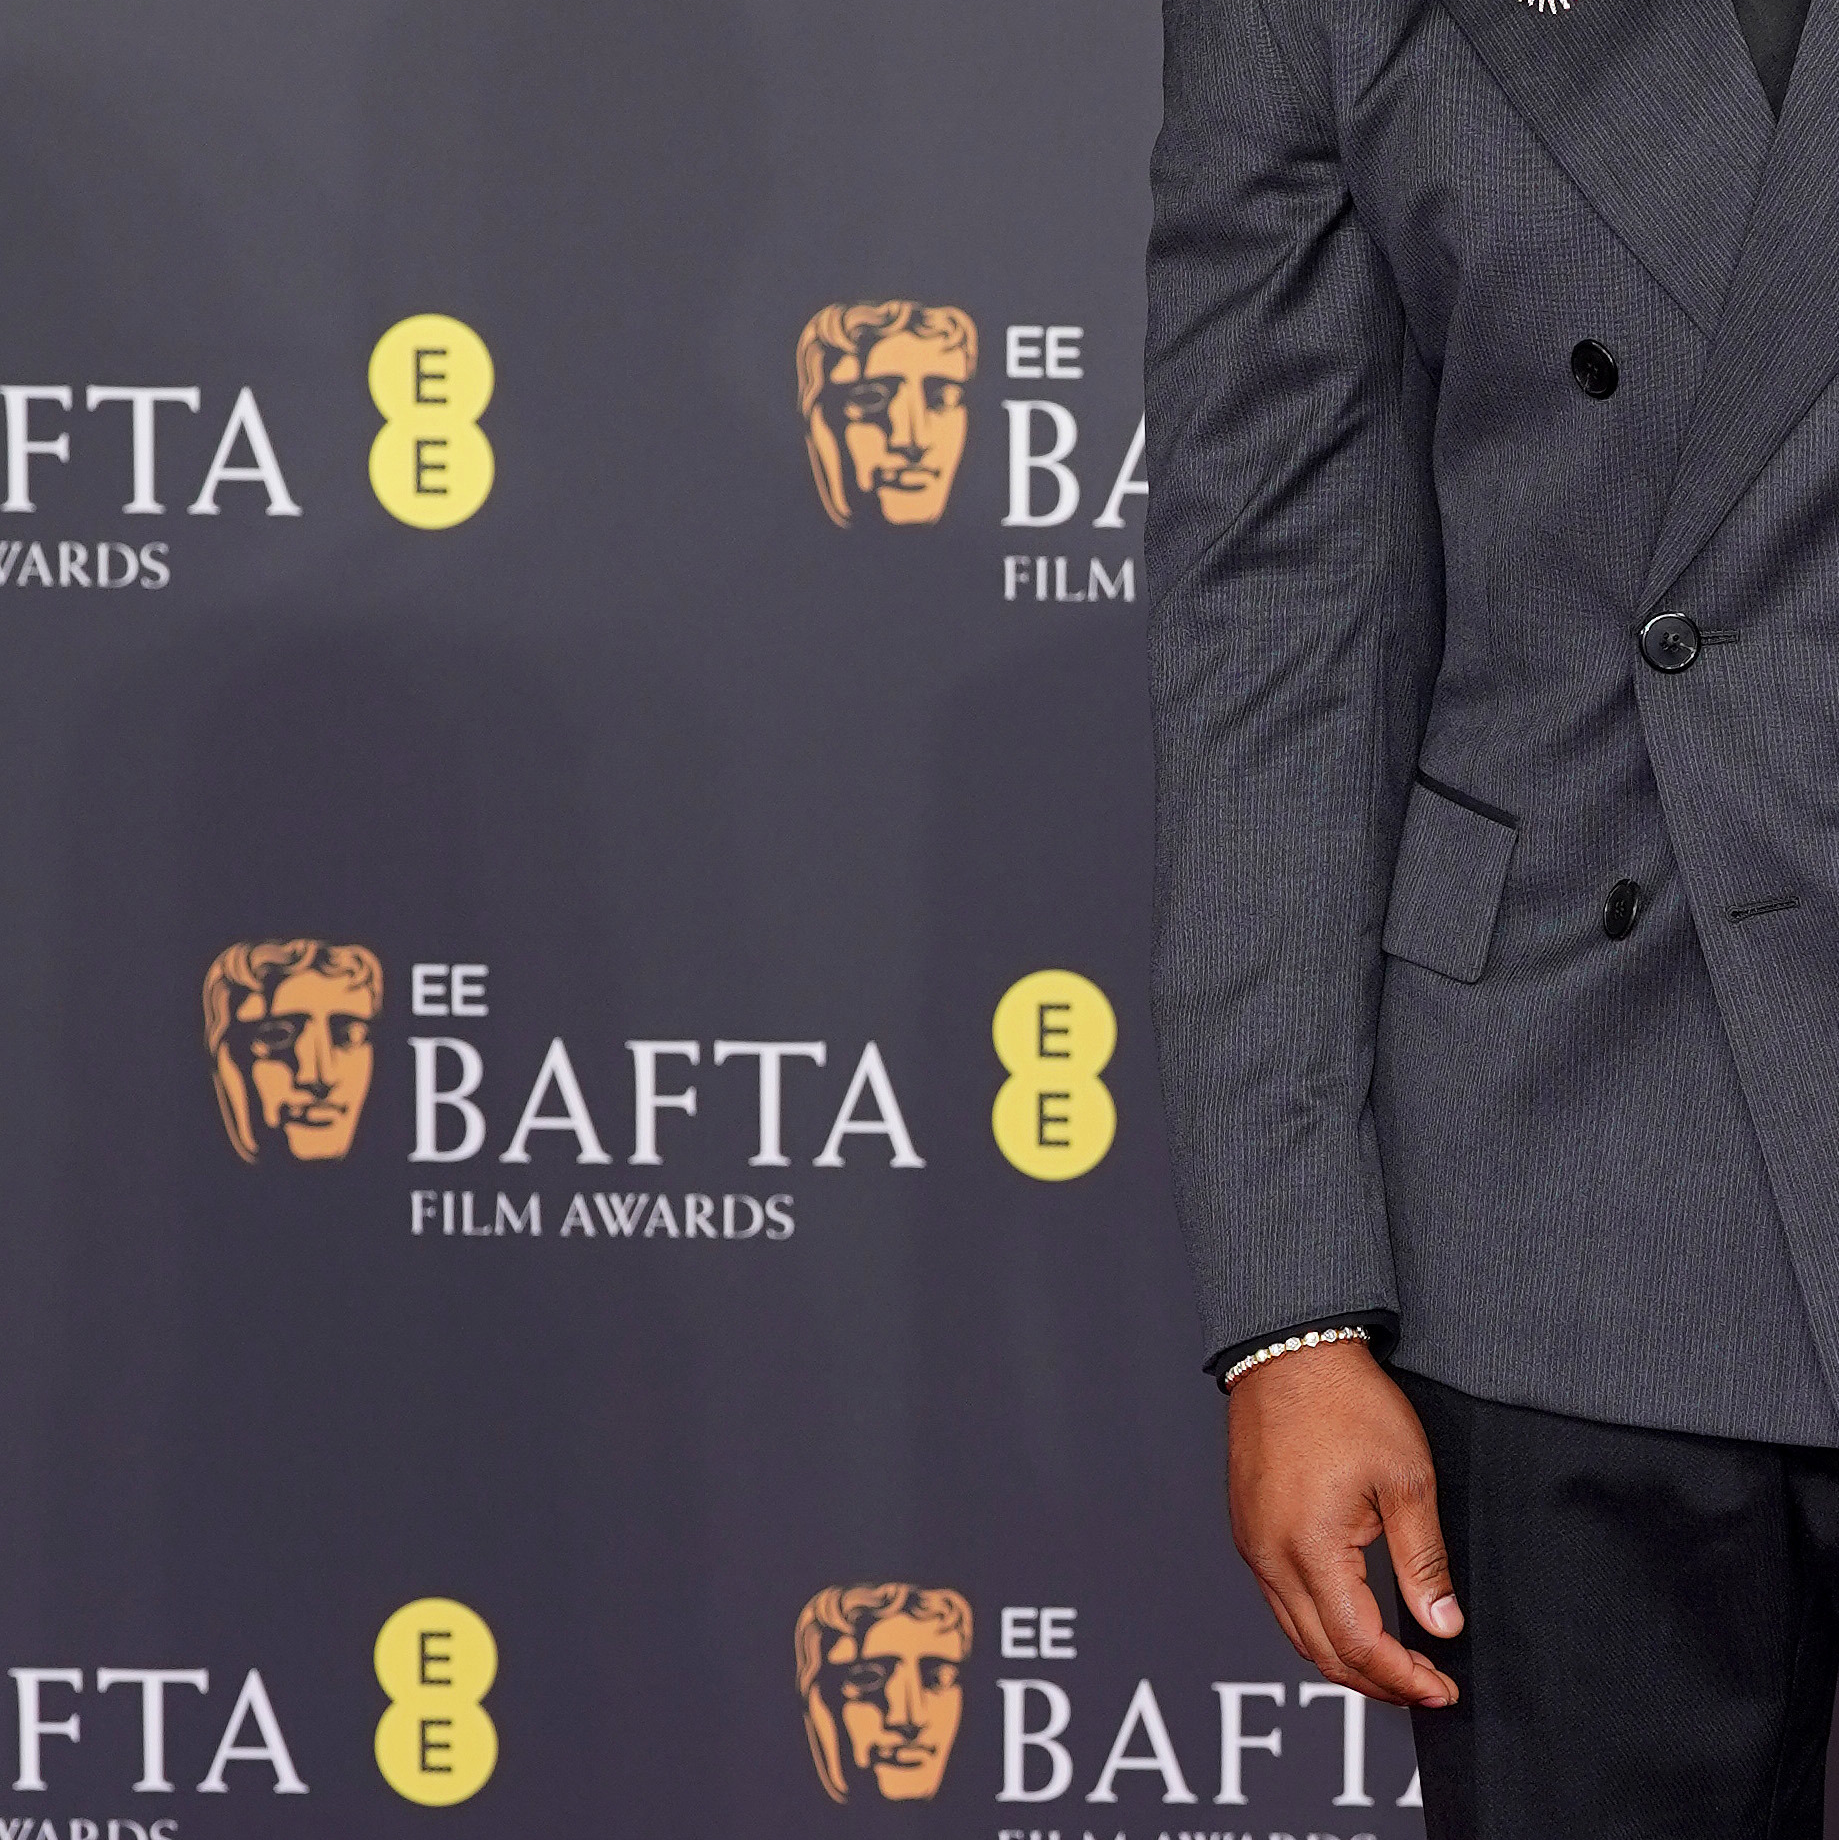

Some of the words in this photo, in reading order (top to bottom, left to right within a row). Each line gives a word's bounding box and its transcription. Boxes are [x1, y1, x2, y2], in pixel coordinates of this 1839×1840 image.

[1006, 325, 1084, 379] EE
[0, 385, 302, 516] FTA
[1004, 556, 1135, 602] FILM
[412, 964, 489, 1016] EE
[408, 1037, 925, 1168] BAFTA
[411, 1191, 541, 1236] FILM
[560, 1193, 794, 1239] AWARDS
[1001, 1607, 1077, 1659] EE
[9, 1667, 308, 1794] FTA
[996, 1679, 1424, 1808] BAFT
